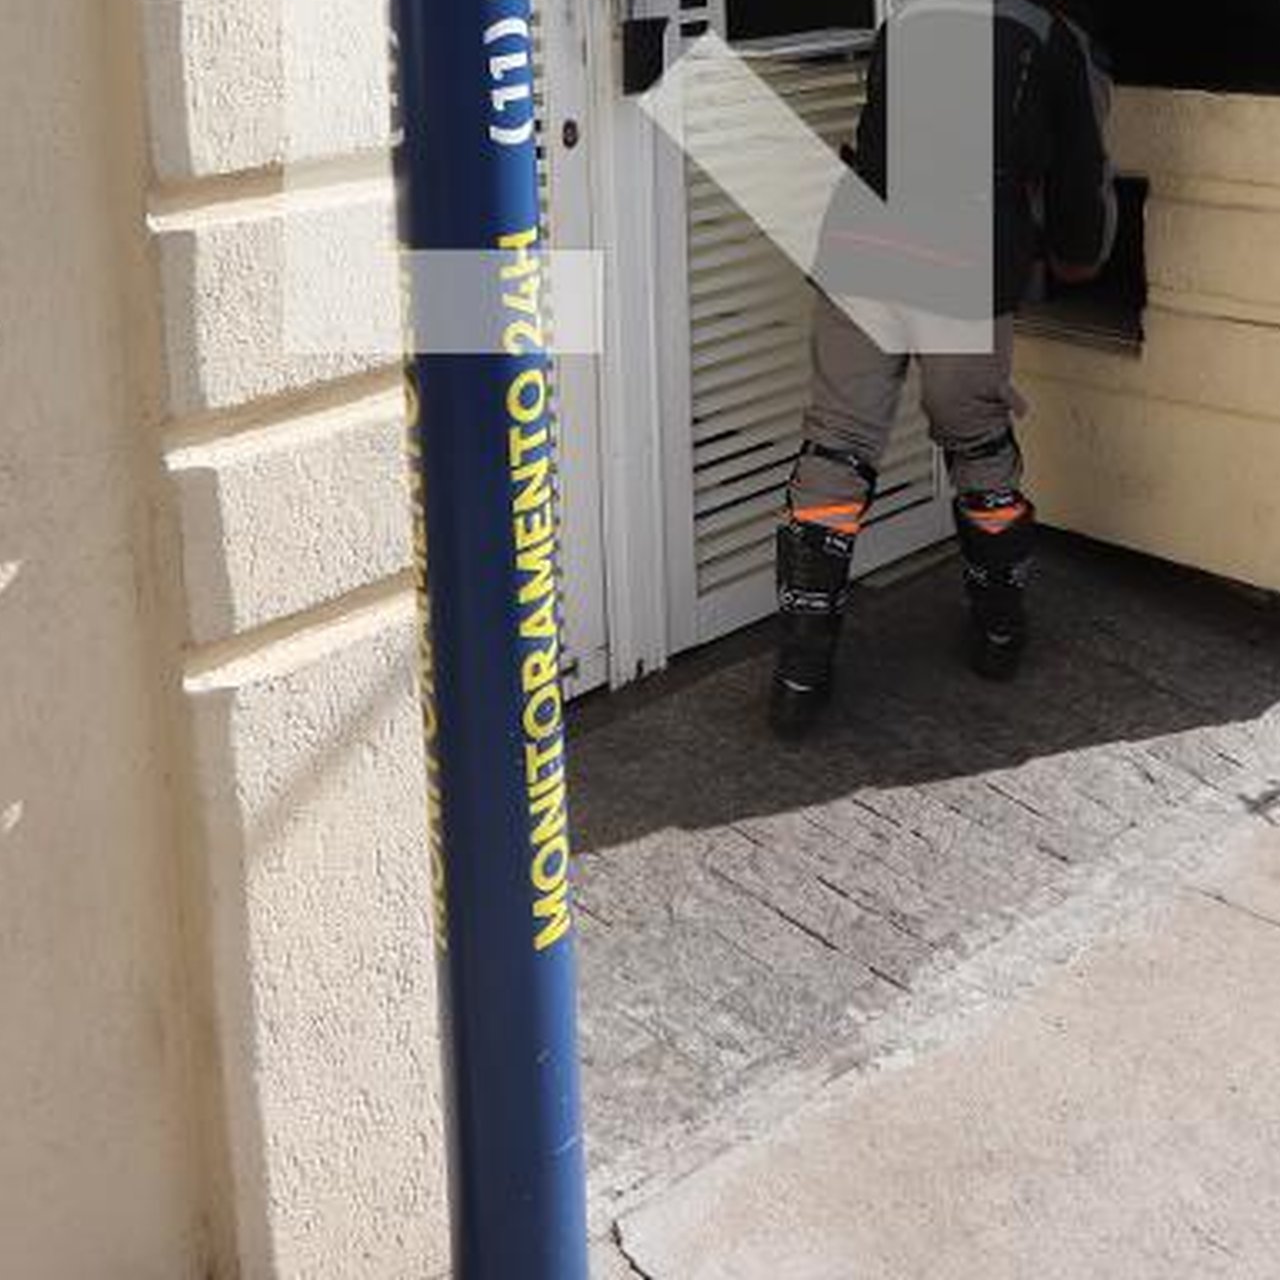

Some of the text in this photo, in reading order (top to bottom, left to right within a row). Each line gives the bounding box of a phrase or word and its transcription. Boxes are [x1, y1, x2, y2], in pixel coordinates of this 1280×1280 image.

[483, 17, 533, 146] (11)
[498, 224, 571, 952] MONITORAMENTO 24H
